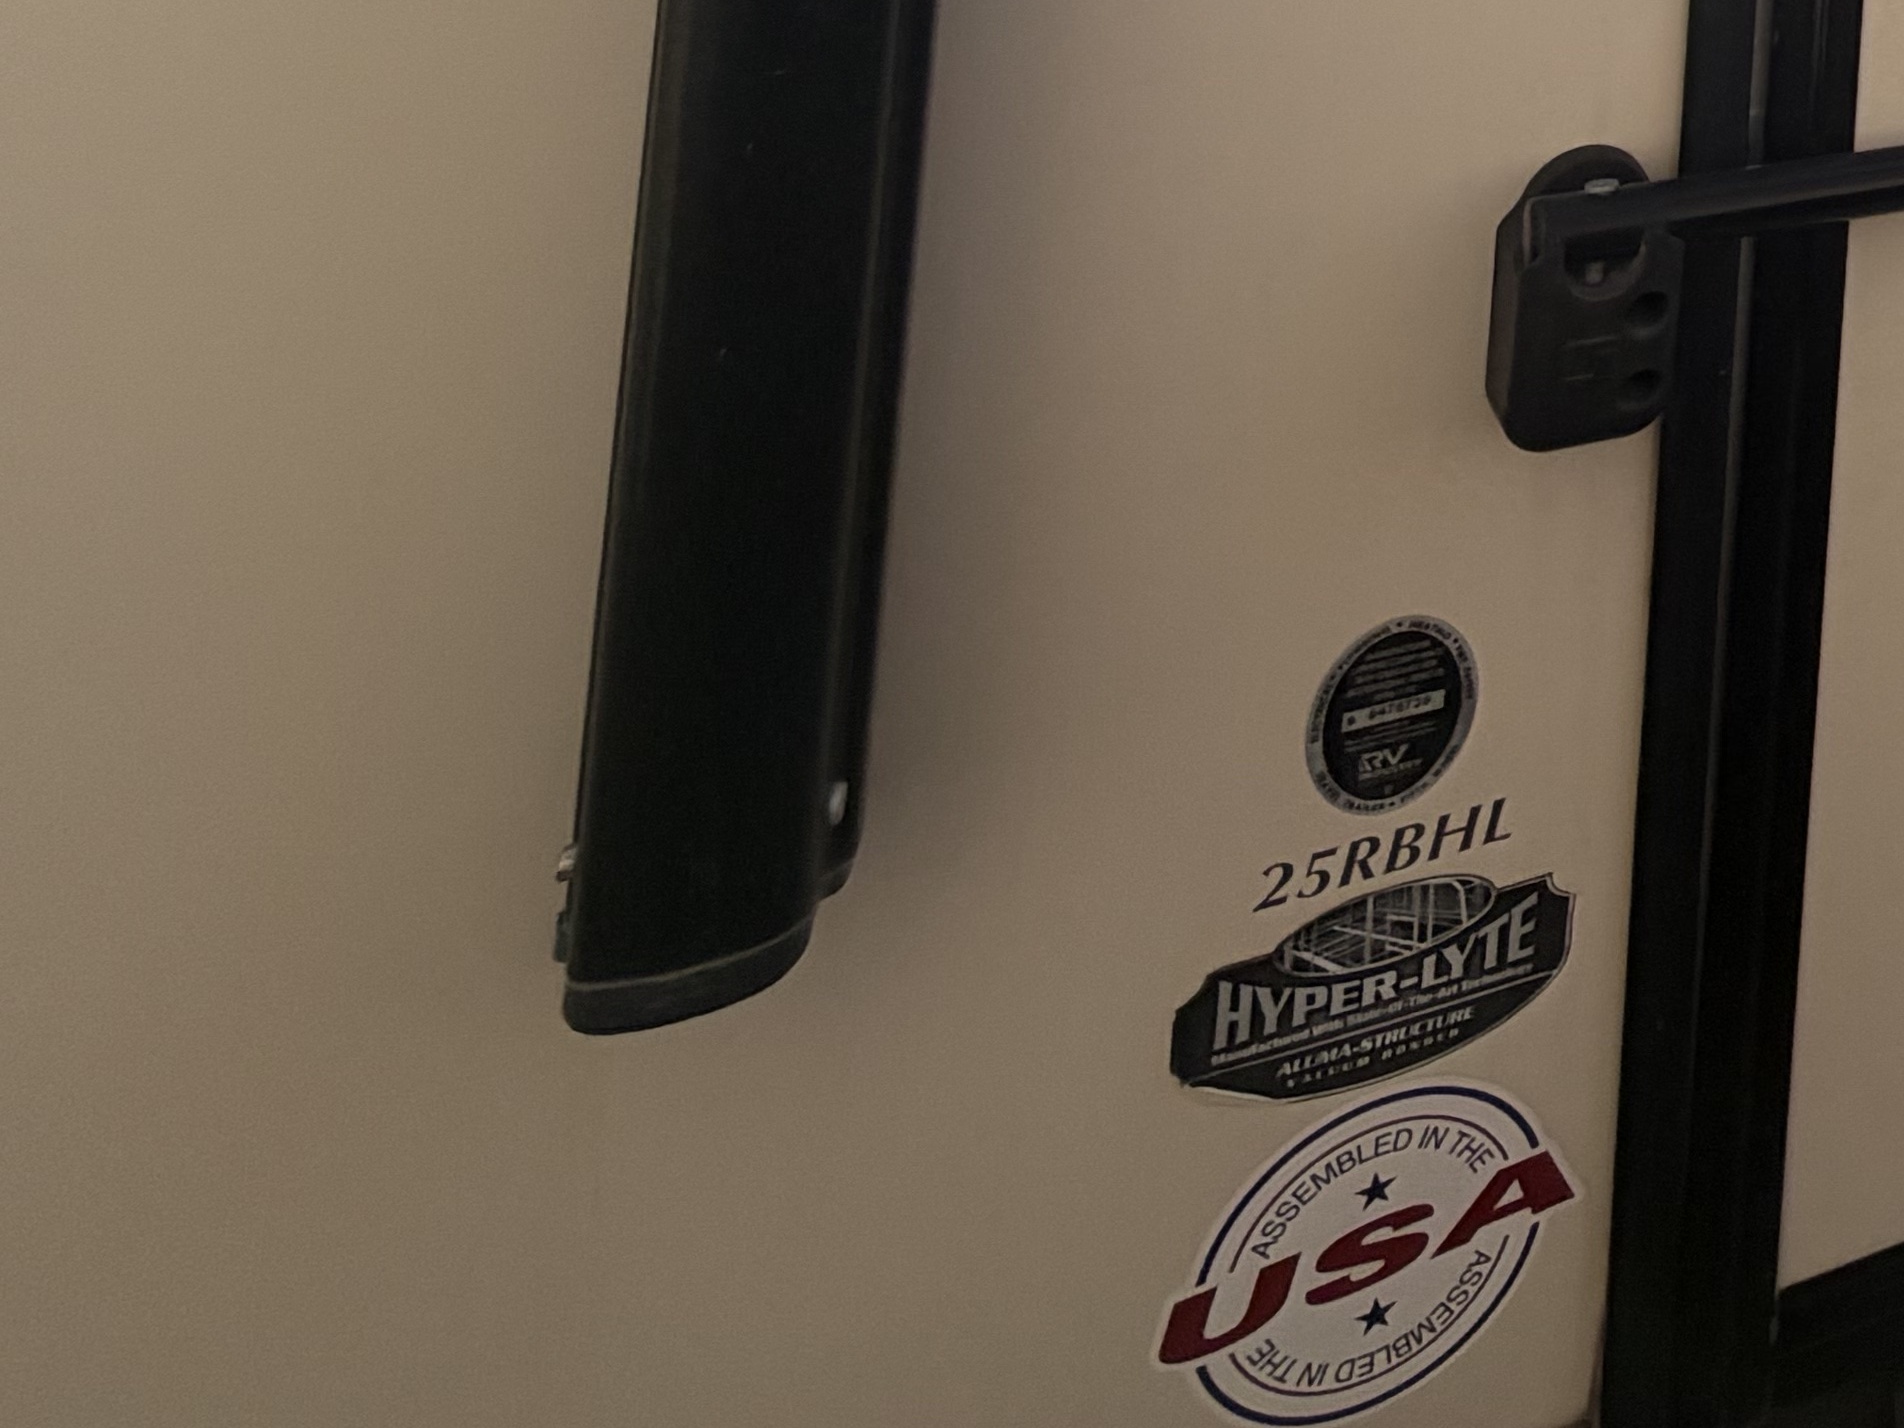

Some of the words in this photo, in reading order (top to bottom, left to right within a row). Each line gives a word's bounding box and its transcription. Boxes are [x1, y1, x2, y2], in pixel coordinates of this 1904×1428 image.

[1252, 797, 1512, 913] 25RBHL
[1212, 891, 1539, 1051] HYPER-LYTE
[1158, 1150, 1576, 1365] USA
[1250, 1127, 1414, 1260] ASSEMBLED
[1418, 1123, 1451, 1152] IN
[1448, 1128, 1496, 1174] THE
[1245, 1336, 1298, 1384] THE
[1296, 1360, 1331, 1388] IN
[1334, 1248, 1493, 1383] ASSEMBLED
